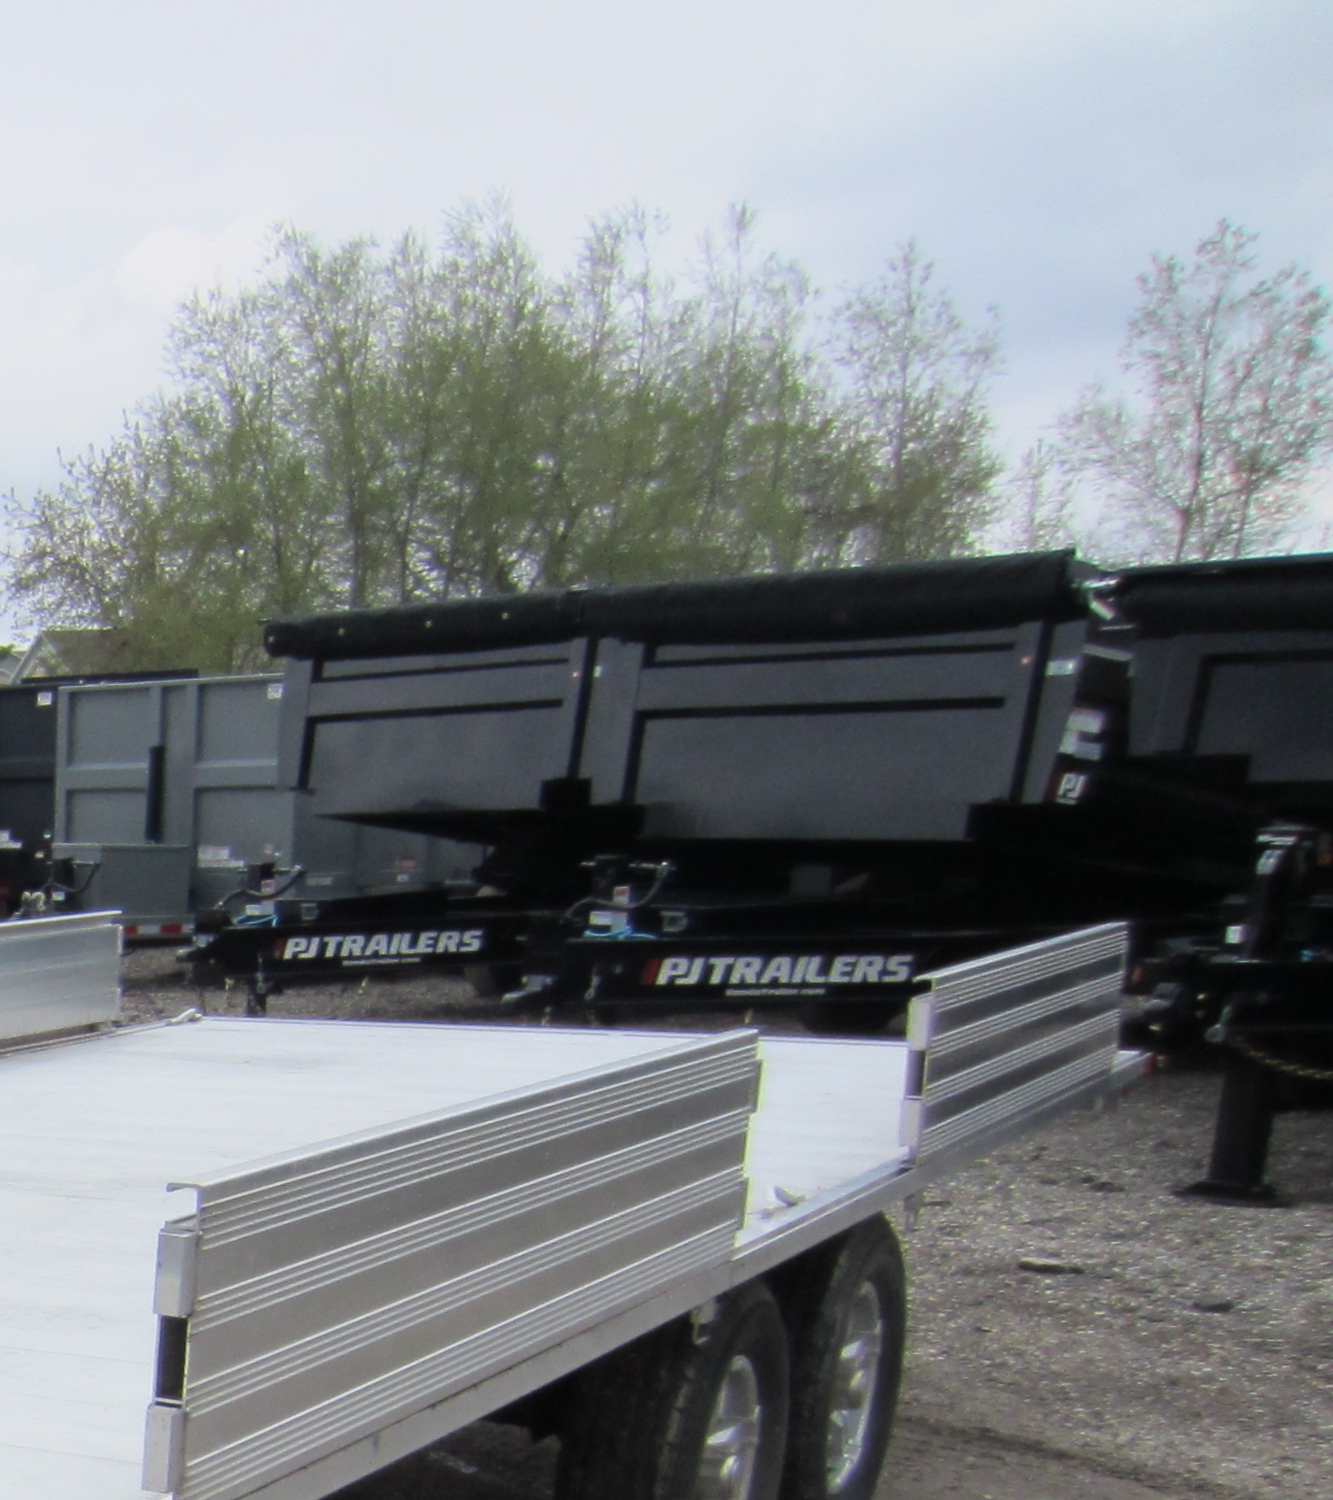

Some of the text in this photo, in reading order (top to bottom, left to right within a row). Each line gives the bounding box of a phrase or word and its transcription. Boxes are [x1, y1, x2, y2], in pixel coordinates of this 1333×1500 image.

[283, 930, 484, 960] PJ TRAILERS
[654, 954, 914, 986] PJ TRAILERS
